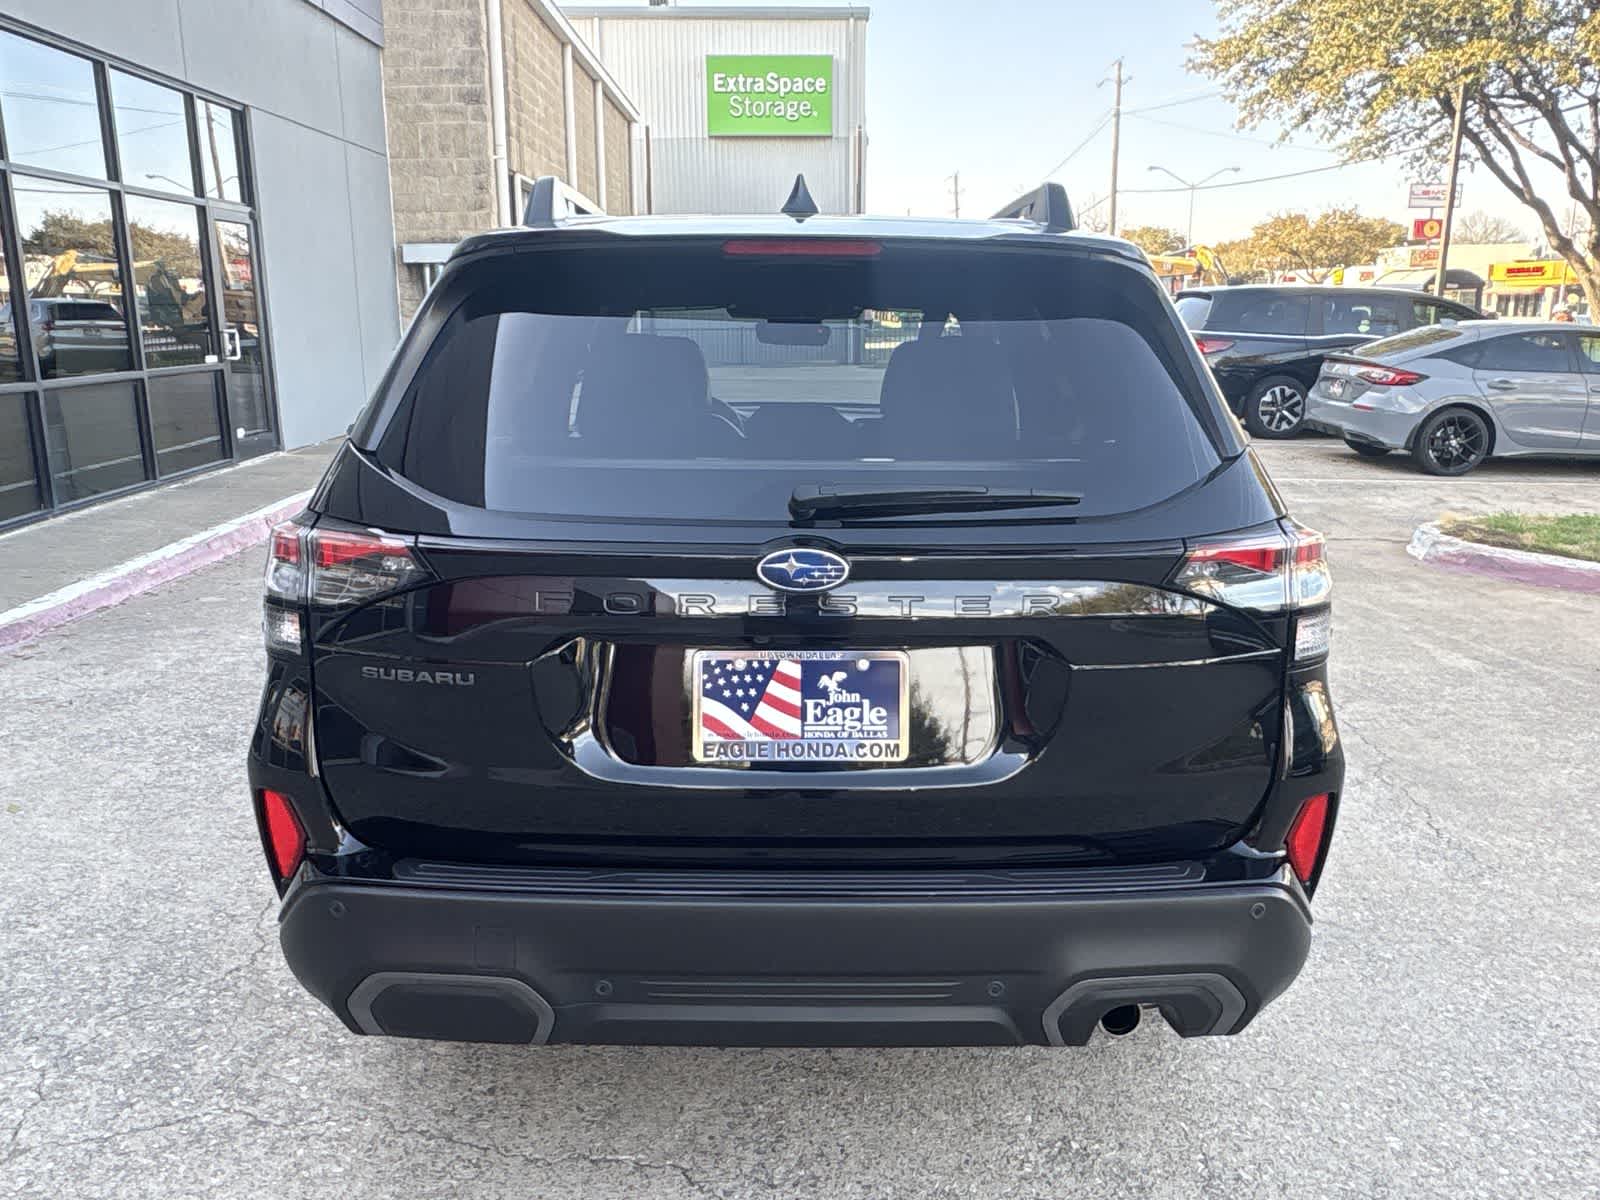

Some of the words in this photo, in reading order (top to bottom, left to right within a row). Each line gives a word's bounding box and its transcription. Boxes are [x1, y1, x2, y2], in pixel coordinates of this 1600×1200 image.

[713, 72, 827, 96] ExtraSpace
[534, 591, 1061, 618] FORESTER
[361, 666, 475, 686] SUBARU
[826, 690, 861, 705] John
[803, 699, 888, 731] Eagle
[804, 731, 836, 739] HONDA
[837, 731, 849, 739] OF
[851, 731, 888, 739] DALLAS
[703, 743, 768, 759] EAGLE
[775, 743, 900, 760] HONDA.COM
